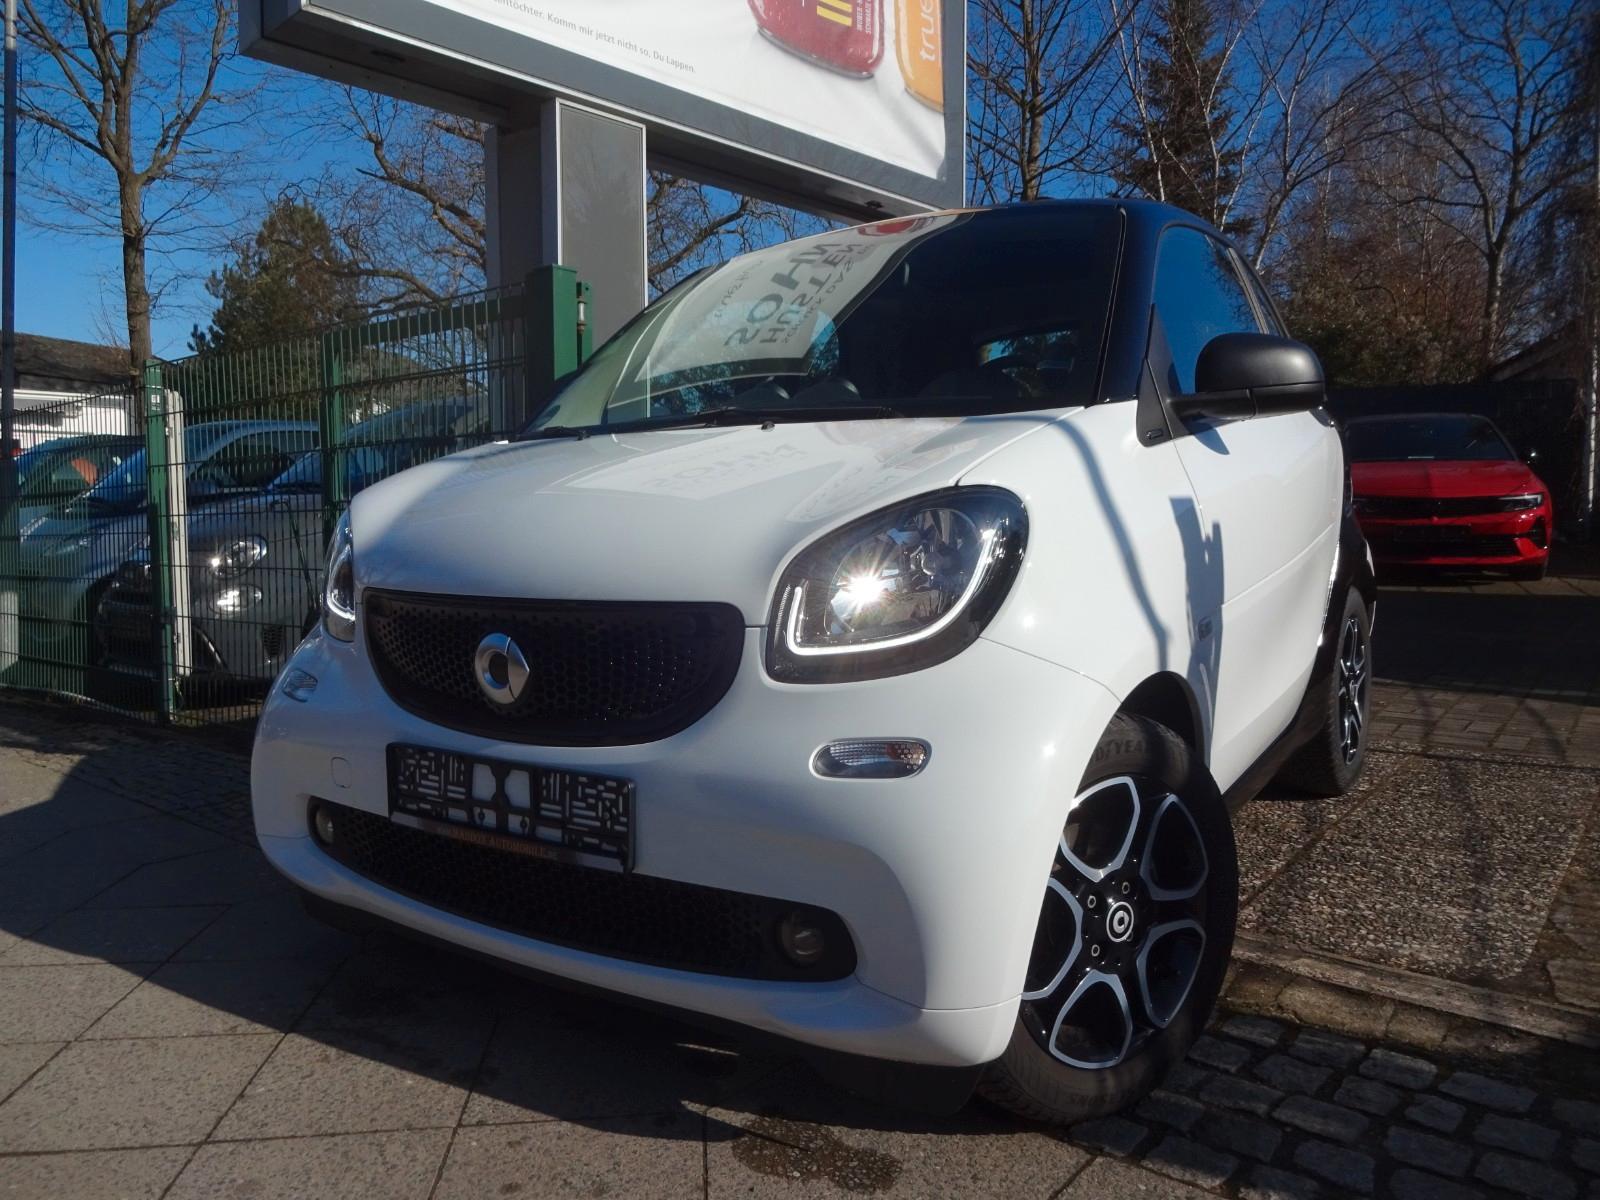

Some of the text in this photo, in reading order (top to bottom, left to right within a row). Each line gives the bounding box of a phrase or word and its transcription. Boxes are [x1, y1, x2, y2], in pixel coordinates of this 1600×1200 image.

[547, 12, 577, 31] Komm
[579, 25, 593, 36] mir
[595, 29, 615, 44] jetzt
[617, 38, 638, 52] nicht
[653, 50, 664, 62] Du
[919, 0, 936, 61] true
